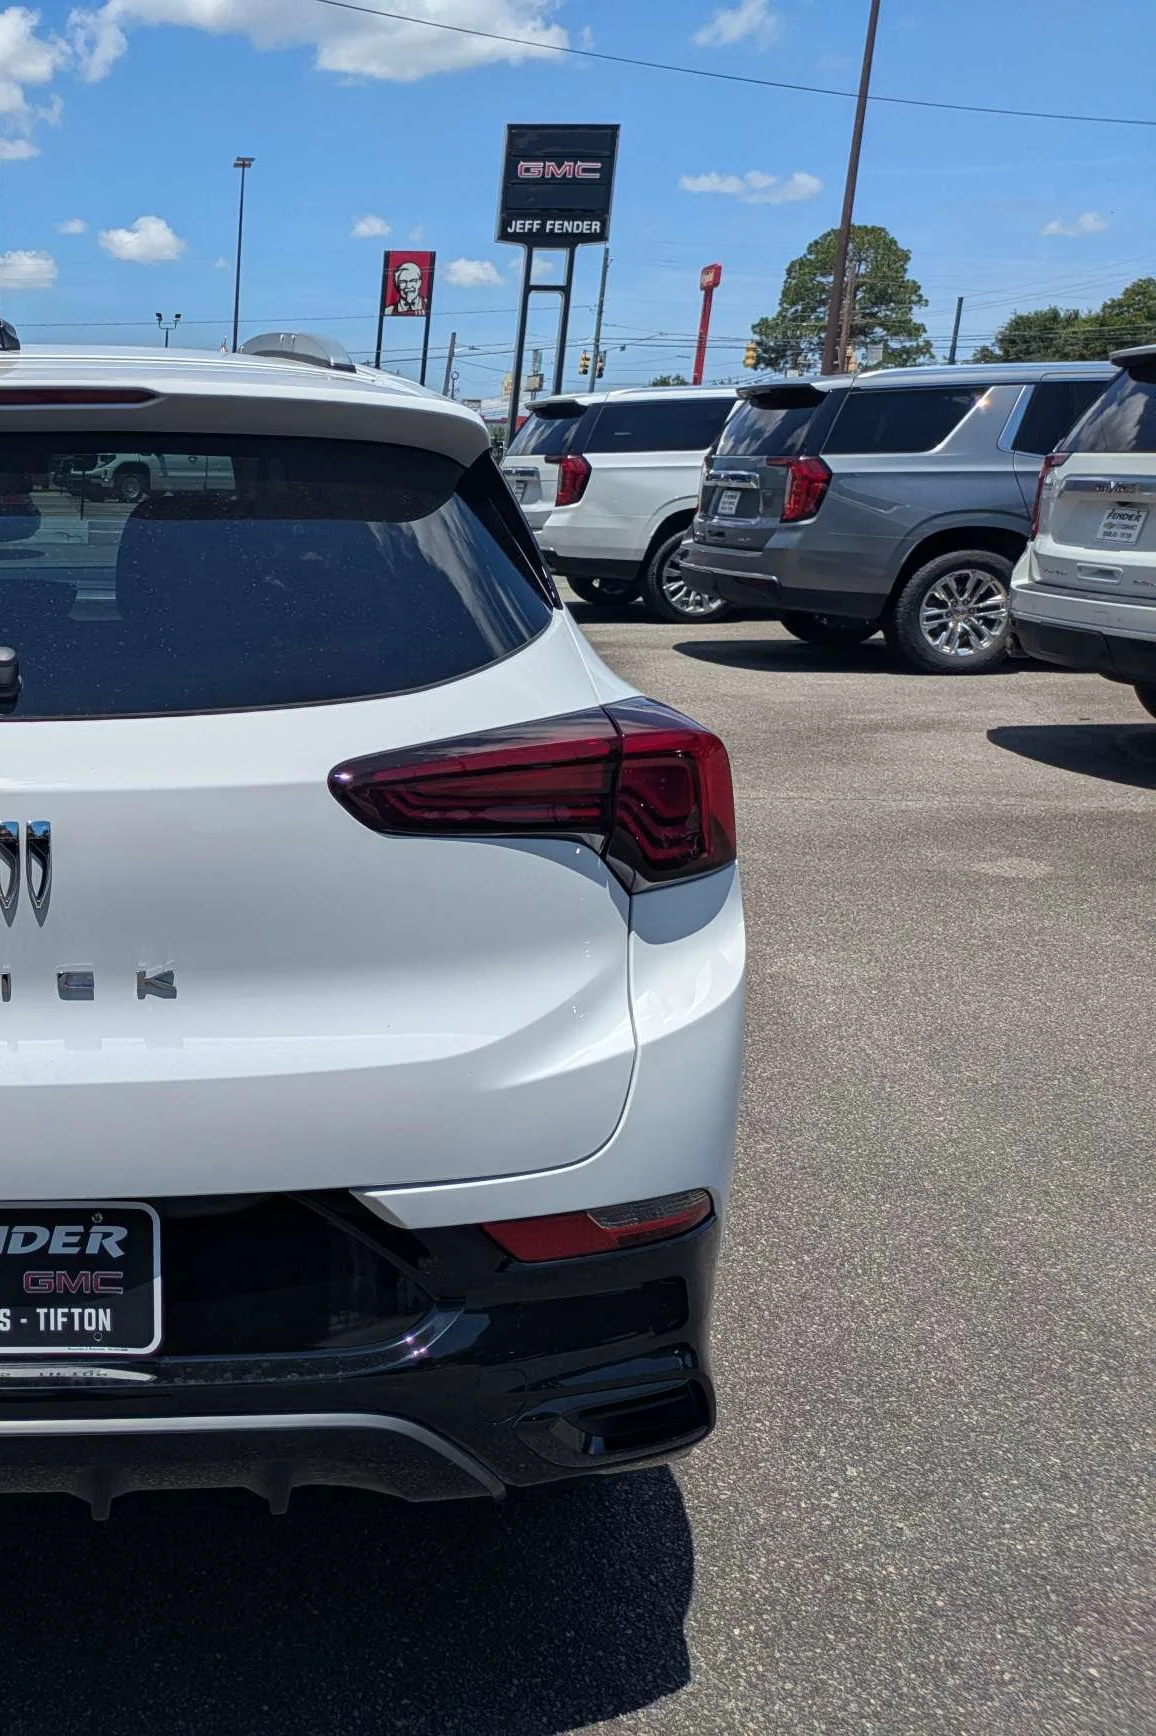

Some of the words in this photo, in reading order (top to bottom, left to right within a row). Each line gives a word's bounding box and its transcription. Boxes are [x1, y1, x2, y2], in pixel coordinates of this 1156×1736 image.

[517, 161, 602, 179] GMC
[507, 220, 542, 233] JEFF
[546, 220, 601, 234] FENDER
[22, 1271, 124, 1295] GMC
[36, 1308, 111, 1332] TIFTON
